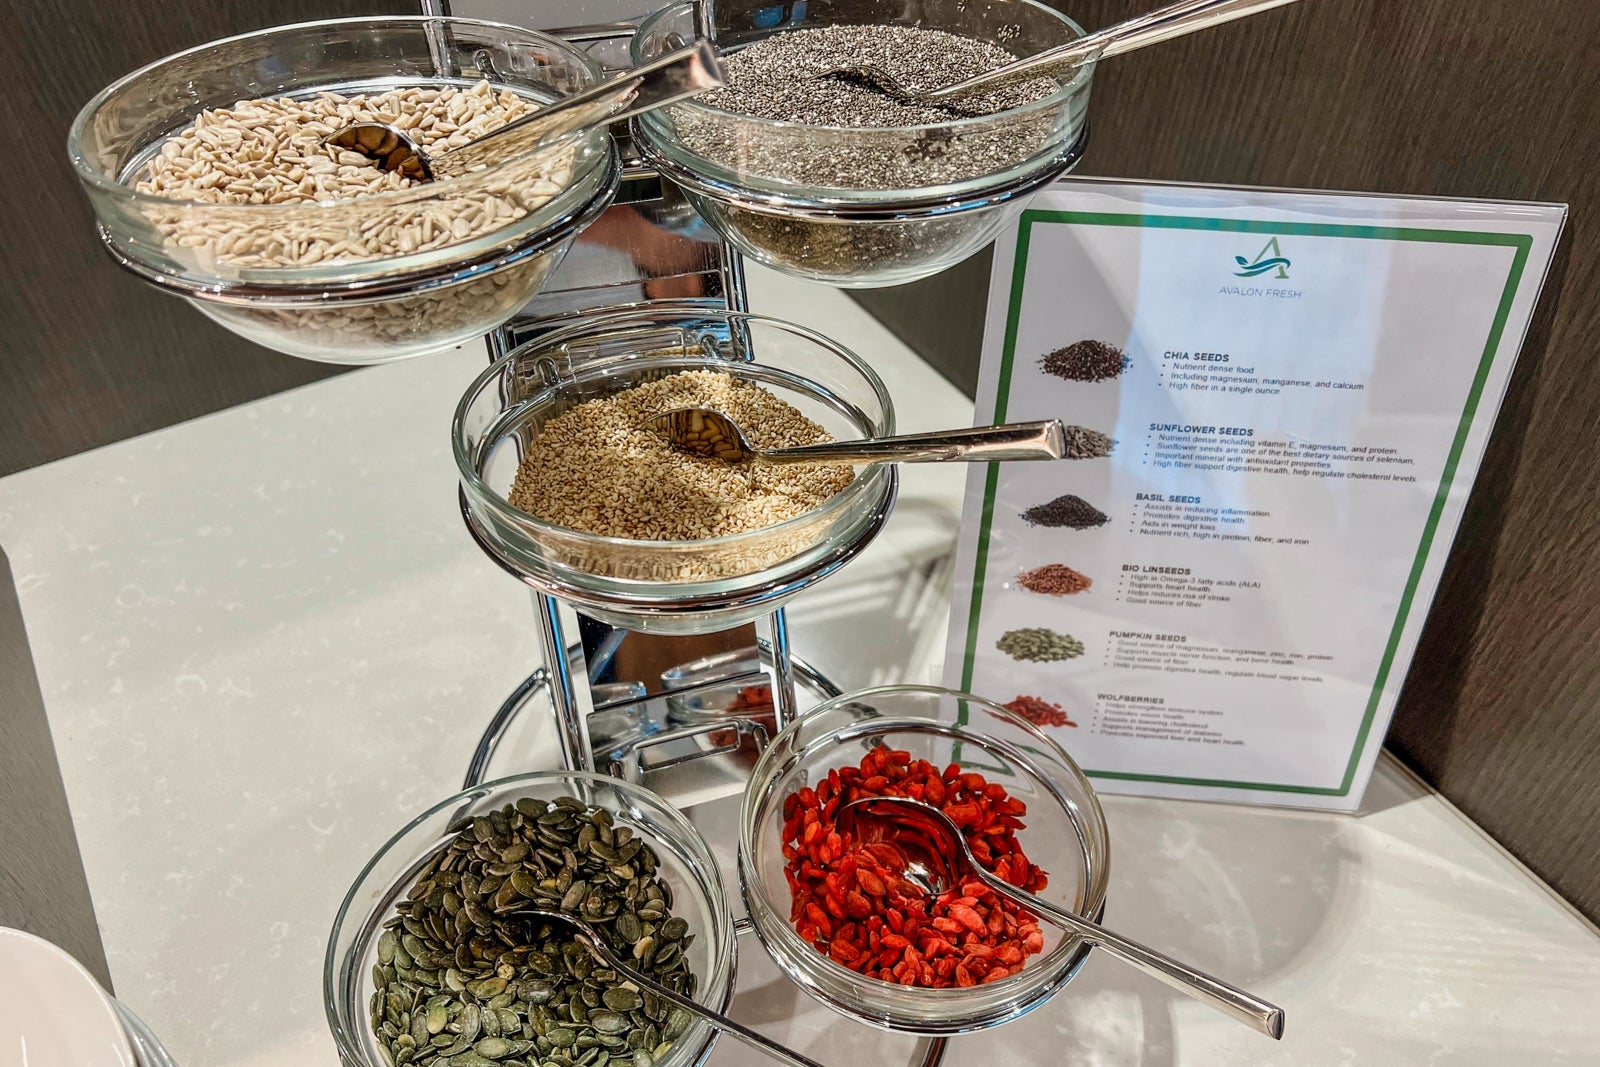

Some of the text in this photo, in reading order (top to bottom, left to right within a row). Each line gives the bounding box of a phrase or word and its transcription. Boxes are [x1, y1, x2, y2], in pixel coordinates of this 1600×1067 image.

[1219, 286, 1302, 298] AVALON FRESH
[1164, 351, 1229, 362] CHIA SEEDS
[1173, 363, 1255, 374] Nutrient dense food
[1171, 373, 1208, 382] Including
[1210, 376, 1260, 385] magnesium,
[1262, 378, 1312, 388] manganese,
[1333, 382, 1364, 390] calcium
[1169, 382, 1188, 390] High
[1191, 382, 1209, 391] fiber
[1229, 384, 1253, 394] single
[1255, 387, 1280, 395] ounce
[1149, 423, 1253, 436] SUNFLOWER SEEDS
[1136, 493, 1201, 503] BASIL SEEDS
[1122, 564, 1191, 575] BIO LINSEEDS
[1109, 631, 1186, 642] PUMPKIN SEEDS
[1097, 693, 1165, 704] WOLFBERRIES
